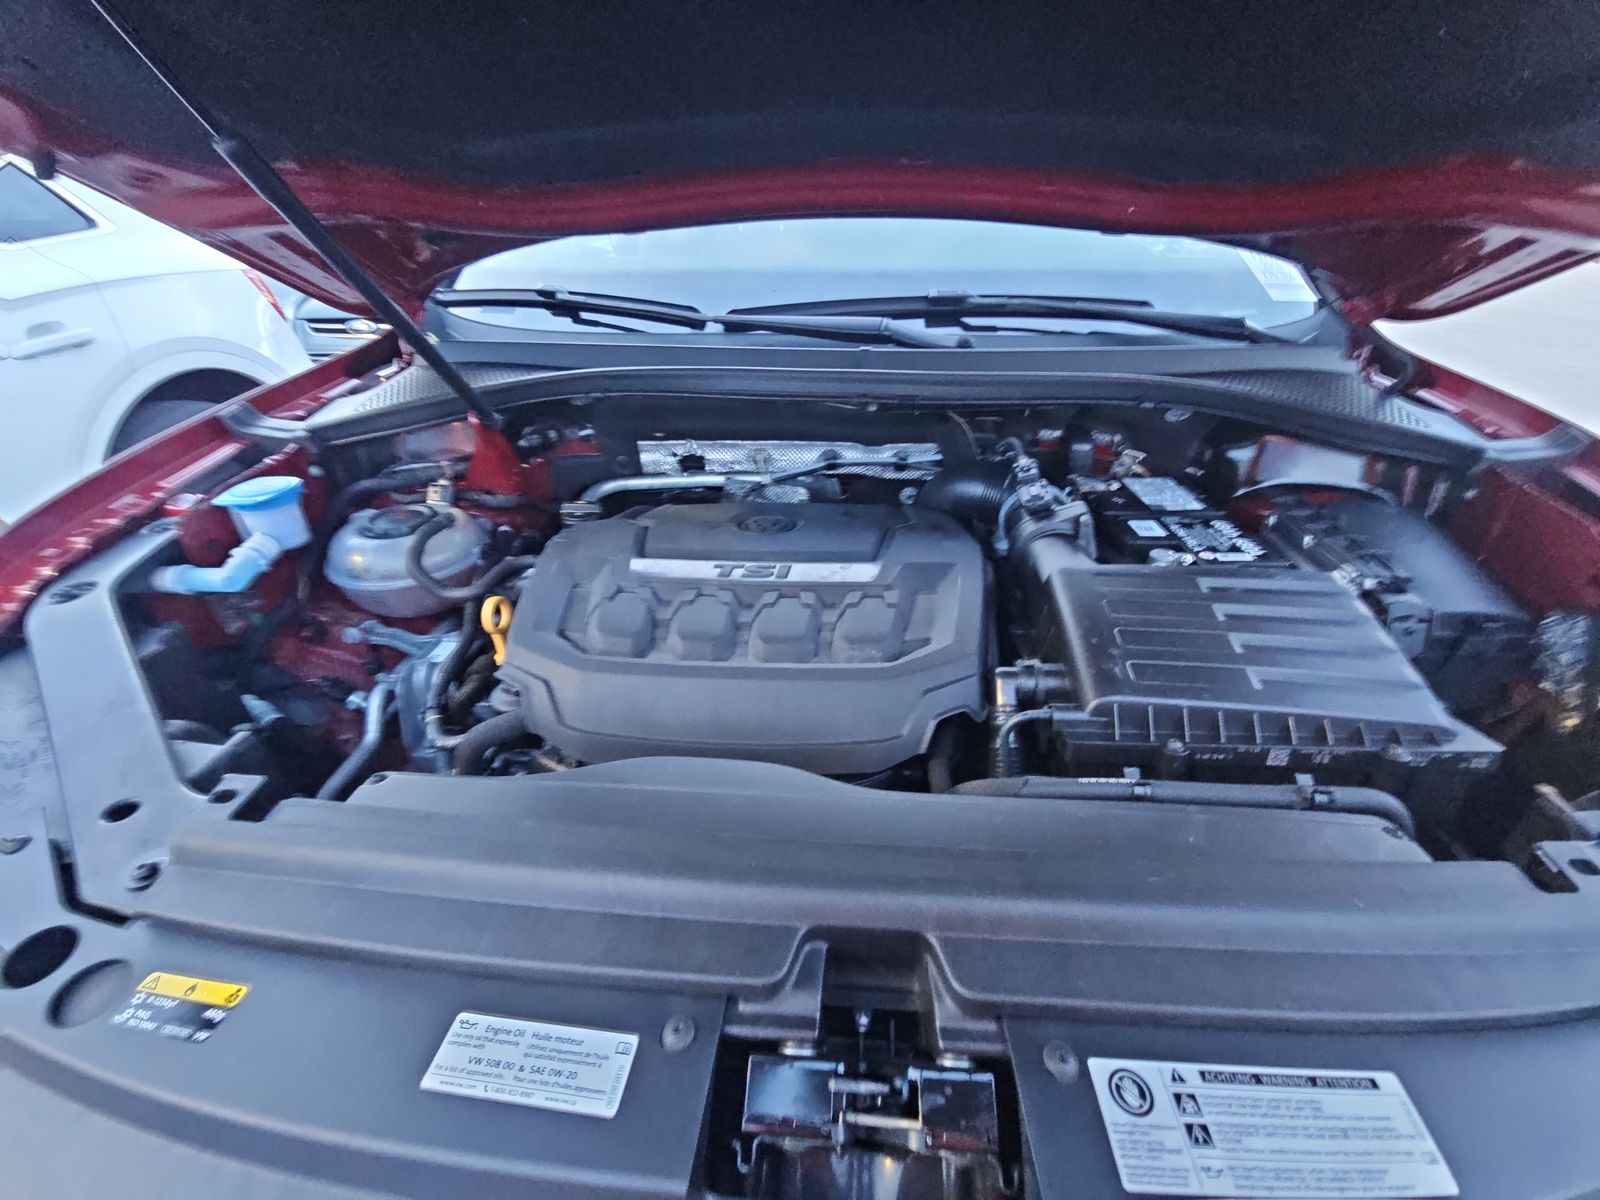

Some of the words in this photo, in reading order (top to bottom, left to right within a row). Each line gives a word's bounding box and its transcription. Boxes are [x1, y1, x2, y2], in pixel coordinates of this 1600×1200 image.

[713, 563, 792, 579] TSI
[485, 1024, 512, 1037] Engine
[514, 1028, 527, 1038] Oil
[532, 1032, 553, 1042] Huile
[553, 1036, 585, 1046] moteur
[468, 1056, 483, 1065] VW
[485, 1058, 502, 1068] 508
[502, 1061, 516, 1070] 00
[529, 1065, 547, 1075] SAE
[547, 1067, 578, 1080] 0W-20
[1204, 1072, 1255, 1085] ACHTUNG
[1259, 1074, 1312, 1087] WARNING
[1316, 1077, 1372, 1090] ATTENTION
